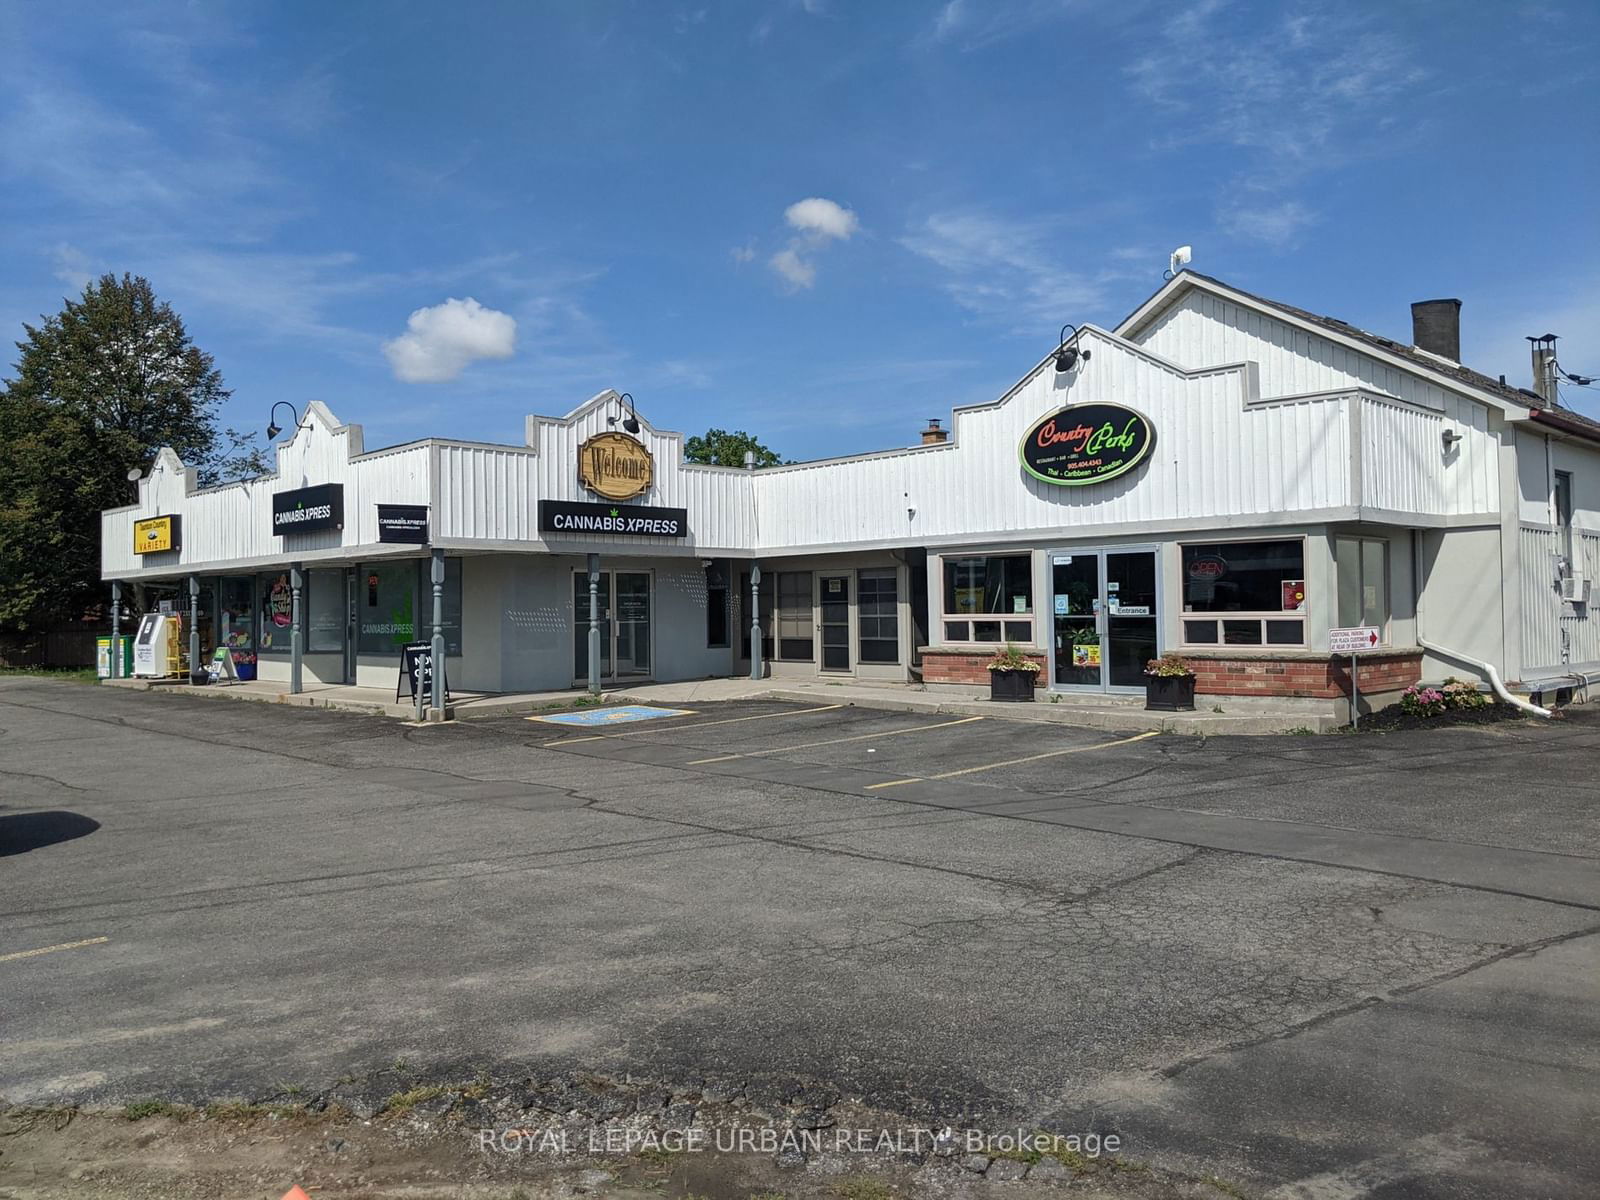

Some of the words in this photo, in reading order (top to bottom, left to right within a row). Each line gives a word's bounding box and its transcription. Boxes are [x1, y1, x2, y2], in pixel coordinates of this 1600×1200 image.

[1037, 419, 1093, 452] Country
[1086, 417, 1138, 455] Perks
[590, 446, 646, 486] Welcome
[274, 509, 305, 525] CANNABIS
[304, 504, 331, 520] XPRESS
[553, 514, 625, 531] CANNABIS
[625, 518, 678, 534] XPRESS
[139, 539, 168, 552] VARIETY
[1190, 561, 1224, 577] OPEN
[1117, 606, 1148, 614] Entrance
[361, 623, 390, 634] CANNABIS
